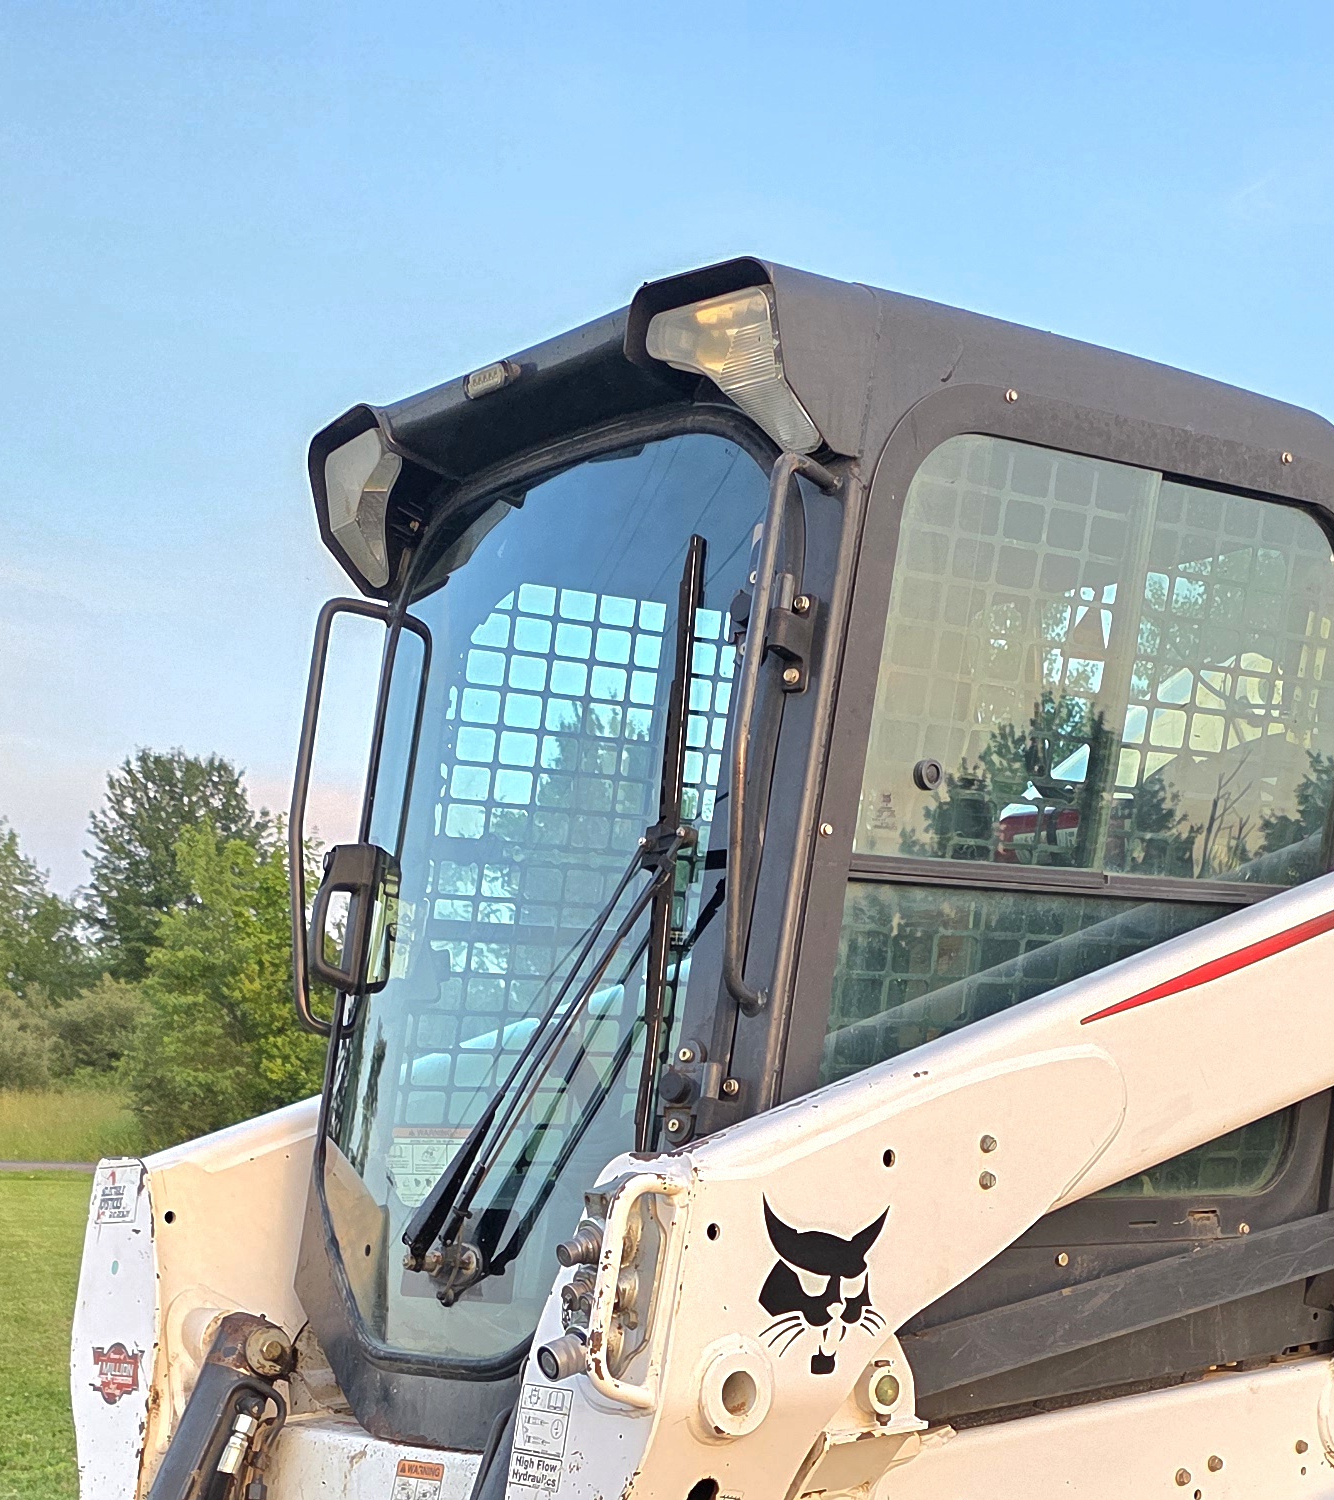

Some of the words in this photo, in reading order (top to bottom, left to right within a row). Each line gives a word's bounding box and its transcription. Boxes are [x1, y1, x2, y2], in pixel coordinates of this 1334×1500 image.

[102, 1361, 135, 1377] MILLION
[406, 1464, 441, 1478] WARNING
[515, 1455, 535, 1470] High
[536, 1459, 558, 1473] Flow
